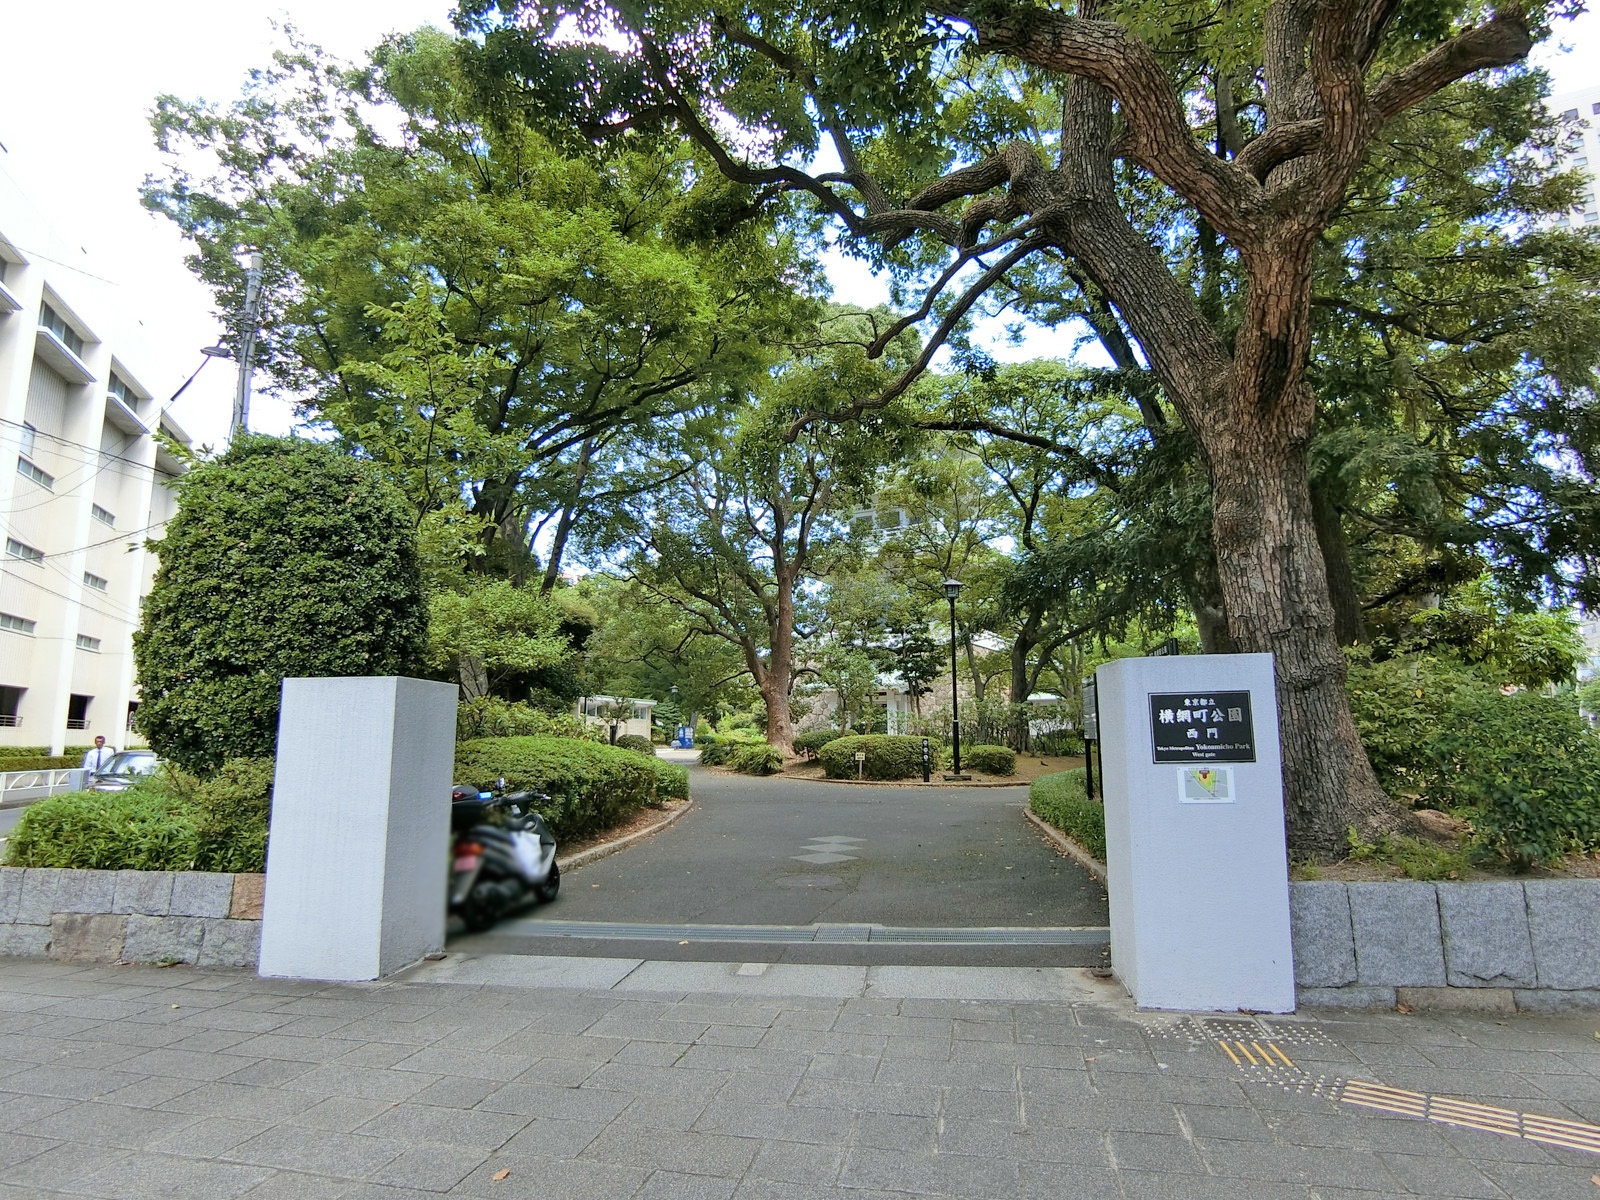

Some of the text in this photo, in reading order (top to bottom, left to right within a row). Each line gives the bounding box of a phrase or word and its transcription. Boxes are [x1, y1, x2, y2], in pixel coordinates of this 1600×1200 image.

[1184, 698, 1216, 707] 東京都立
[1158, 707, 1243, 724] 横網町公園
